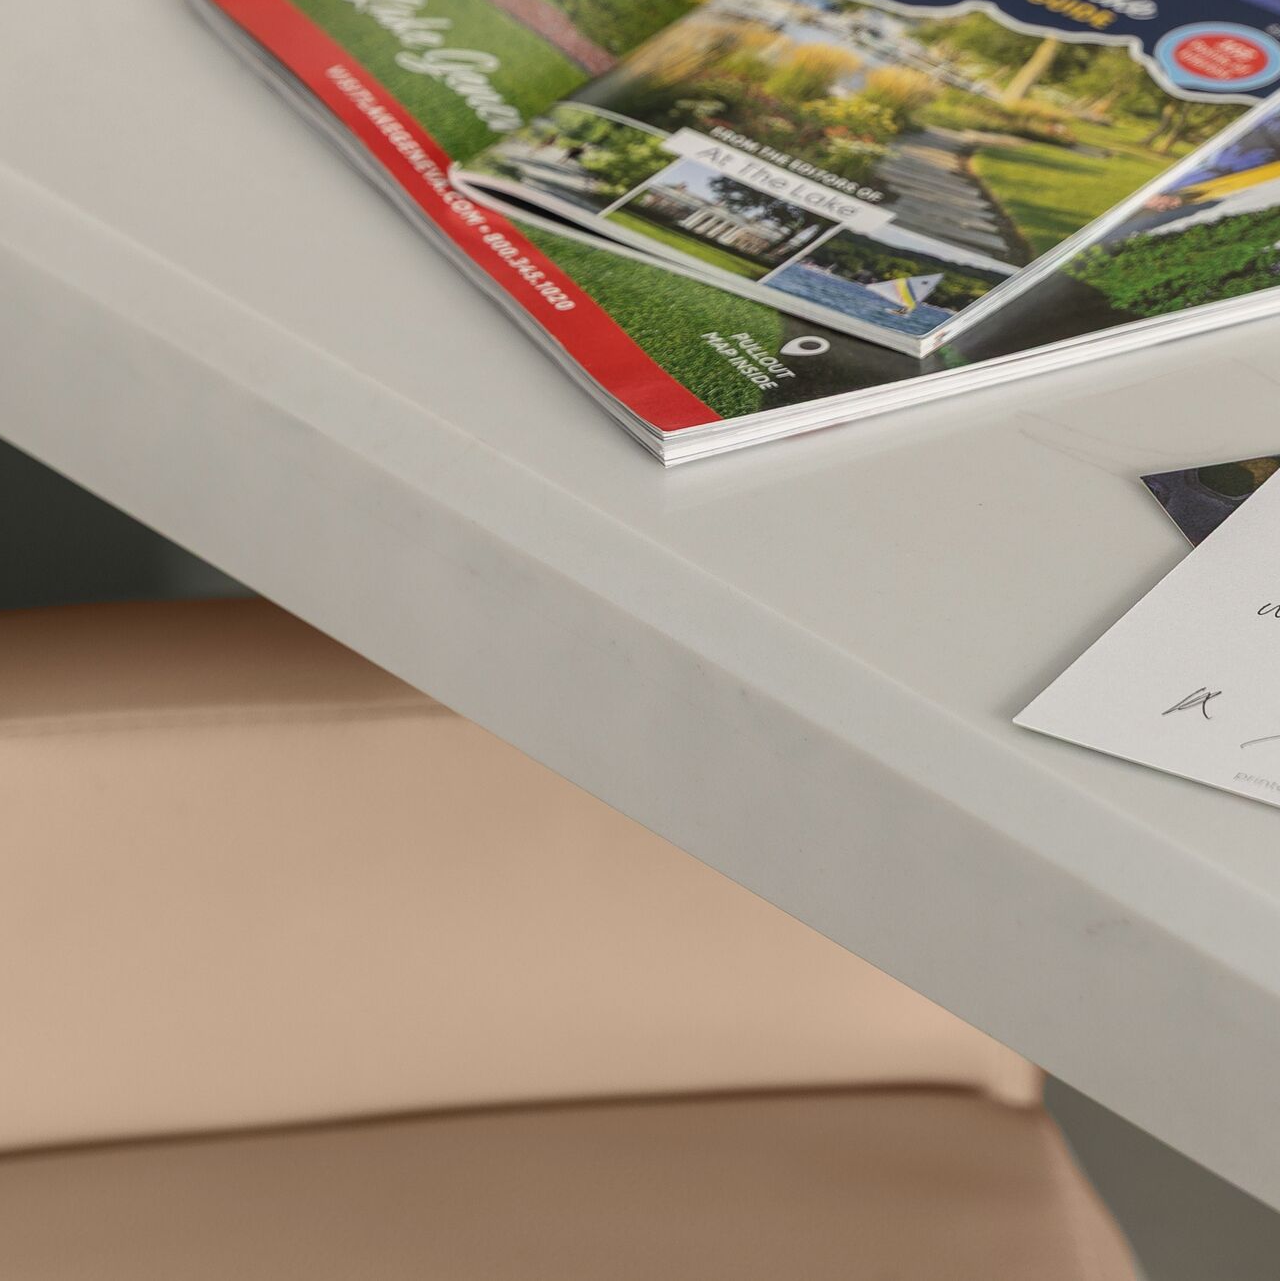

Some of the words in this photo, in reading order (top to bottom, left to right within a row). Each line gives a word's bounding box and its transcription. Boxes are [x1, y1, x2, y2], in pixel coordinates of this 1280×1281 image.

[709, 125, 761, 154] FROM
[759, 145, 792, 167] THE
[788, 158, 860, 195] EDITORS
[856, 186, 886, 203] OF
[738, 164, 787, 190] The
[790, 183, 858, 218] Lake
[700, 332, 738, 358] MAP
[728, 356, 779, 390] INSIDE
[730, 332, 796, 379] PULLOUT
